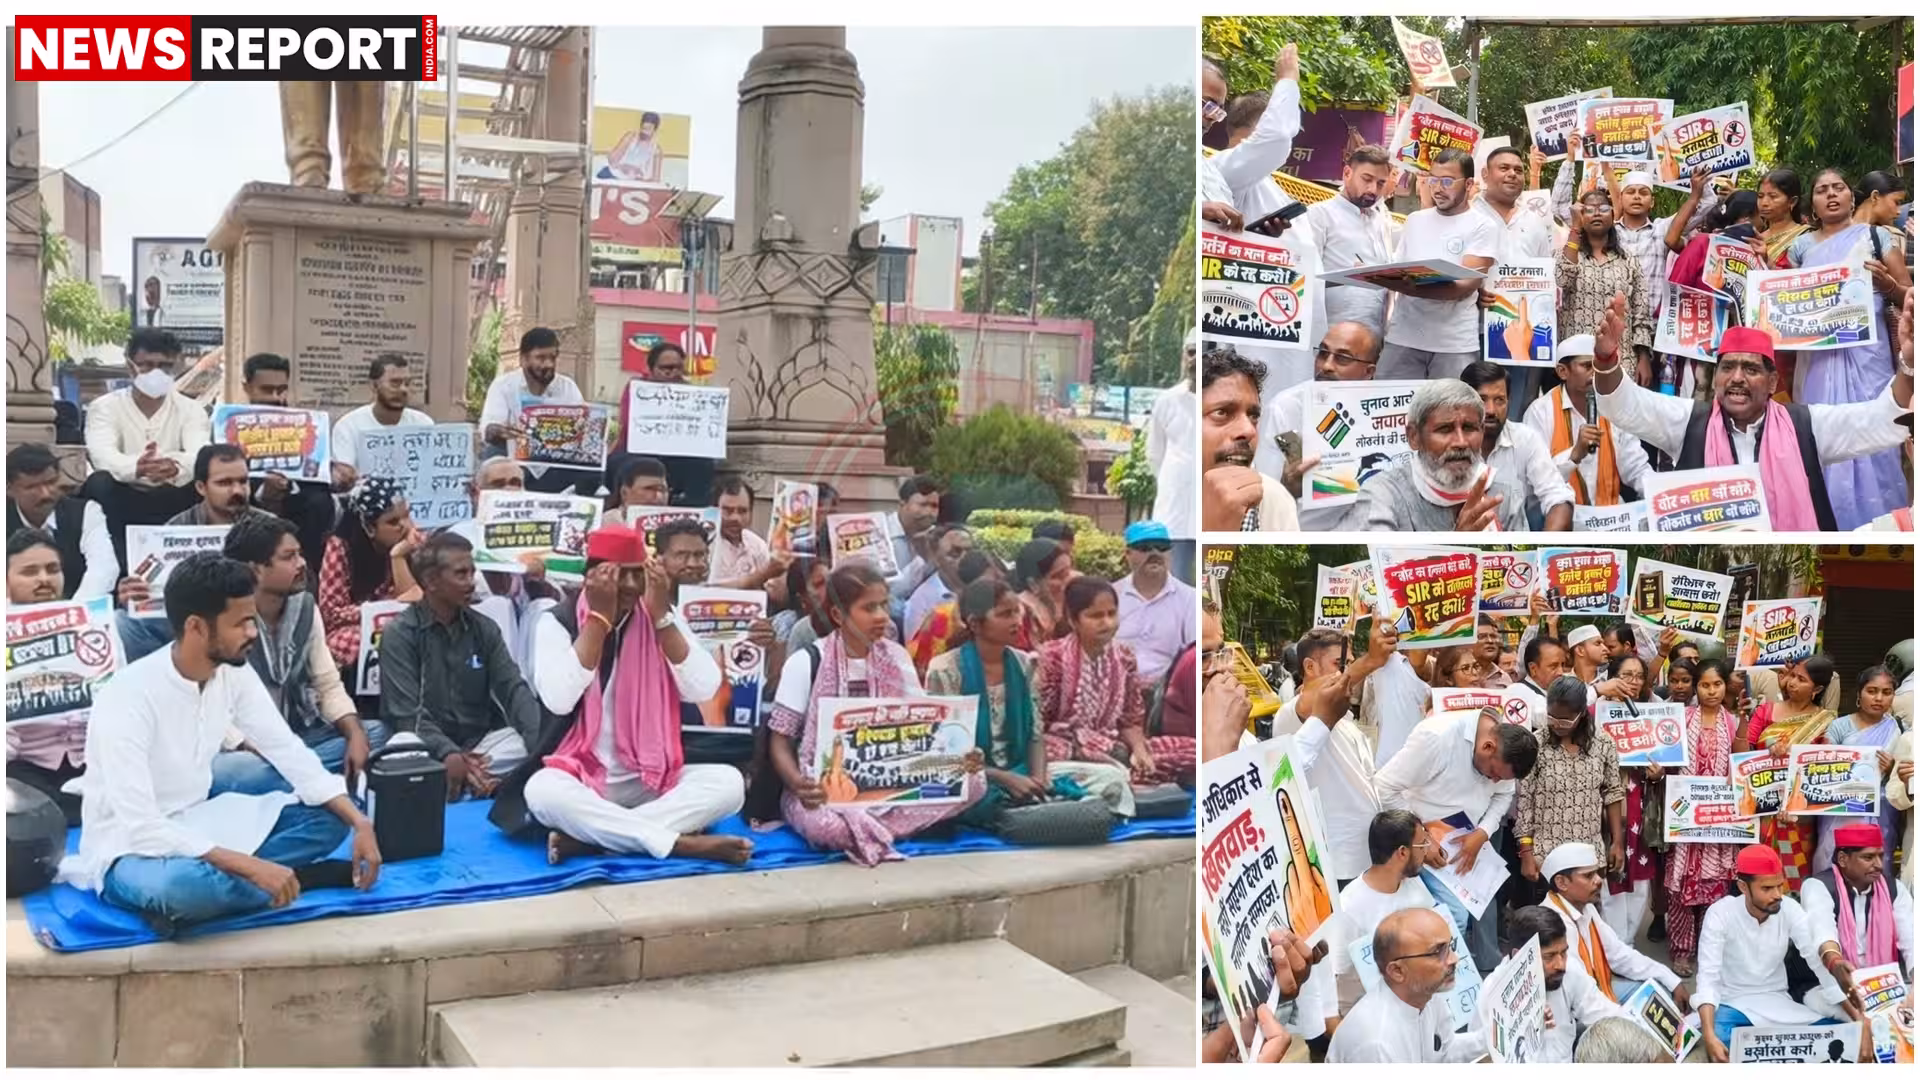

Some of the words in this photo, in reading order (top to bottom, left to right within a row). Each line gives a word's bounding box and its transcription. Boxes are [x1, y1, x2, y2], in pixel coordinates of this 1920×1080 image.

[1420, 127, 1439, 145] SIR
[1677, 120, 1703, 143] SIR
[1223, 262, 1239, 278] को
[1360, 396, 1390, 416] चुनाव
[1406, 581, 1430, 604] SIR
[1432, 577, 1445, 597] को
[1765, 608, 1789, 627] SIR
[1752, 769, 1773, 787] SIR
[1202, 774, 1249, 823] अधिकार
[1246, 762, 1262, 791] से
[1242, 857, 1263, 889] देश
[1260, 845, 1278, 871] का
